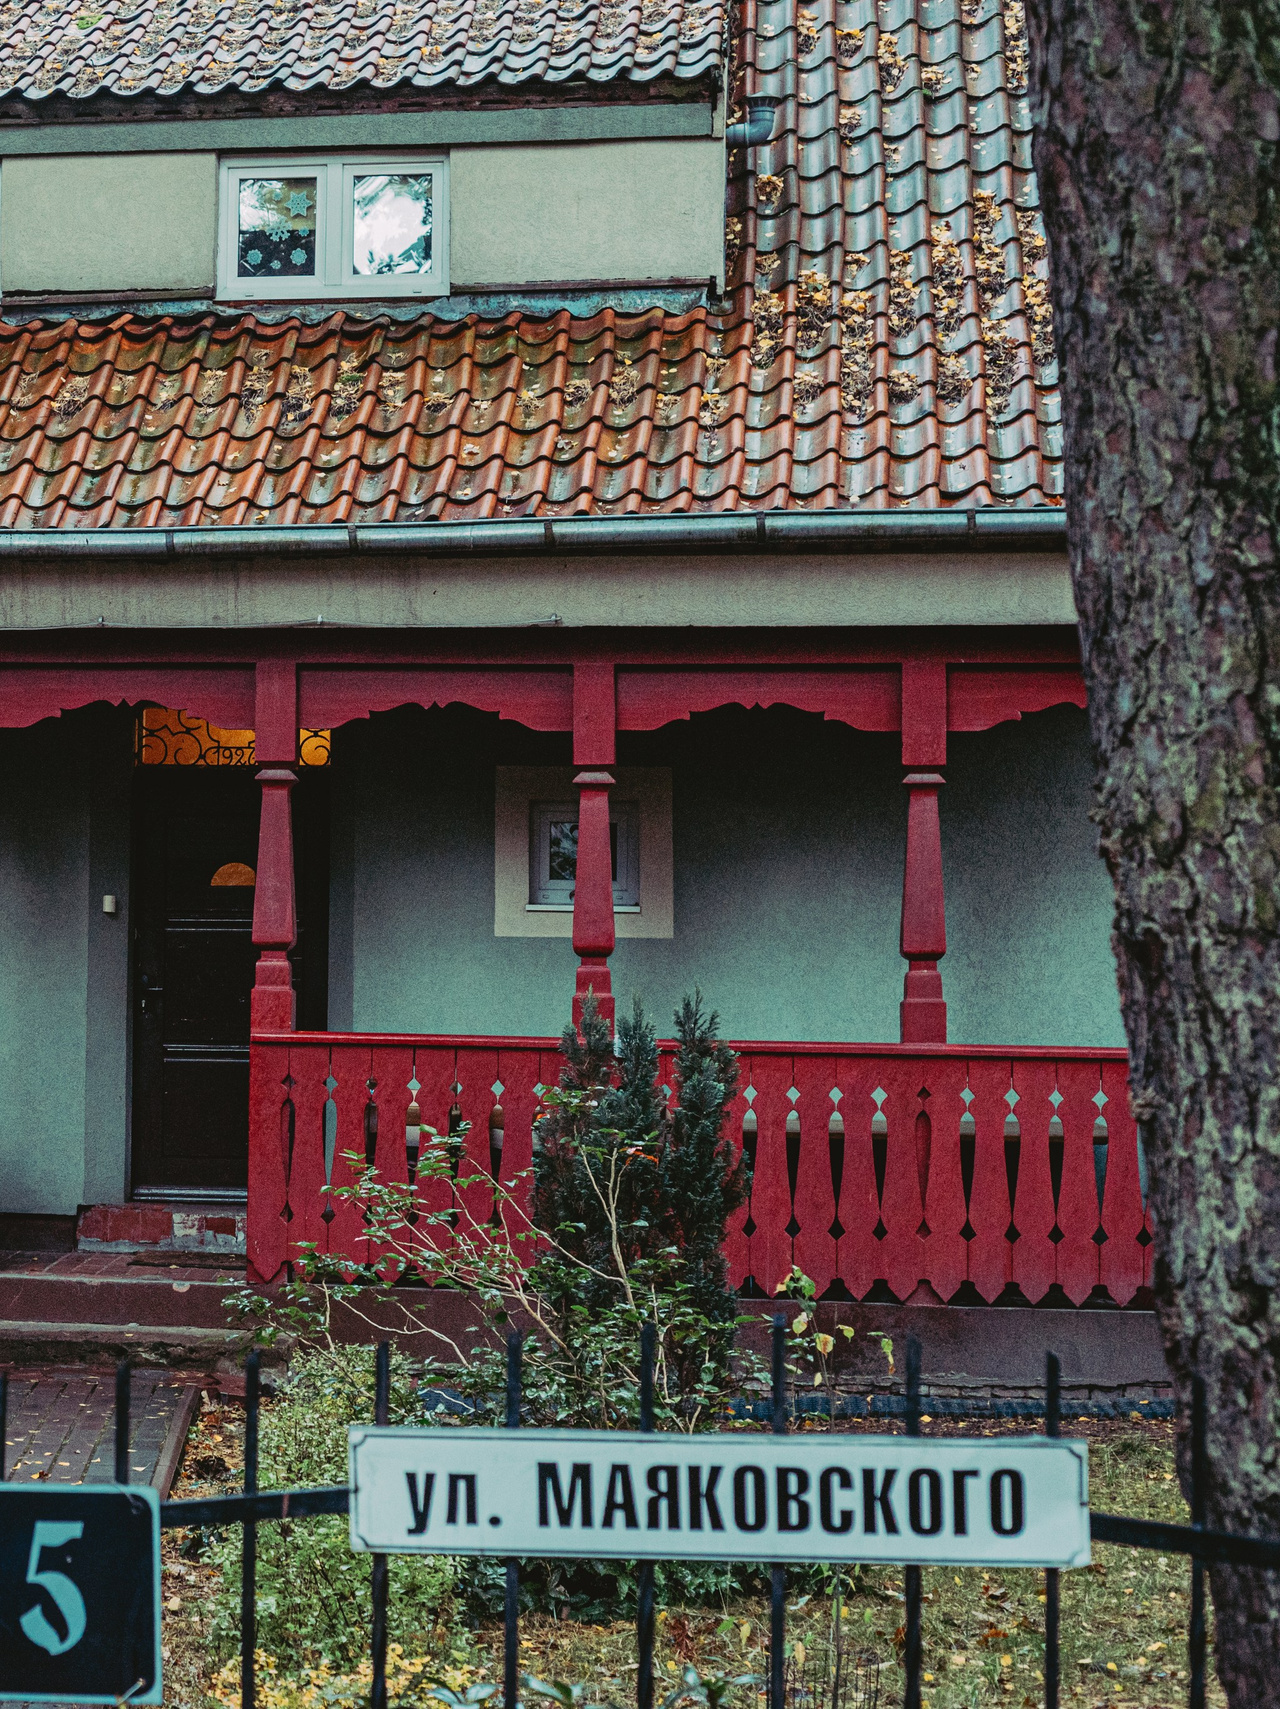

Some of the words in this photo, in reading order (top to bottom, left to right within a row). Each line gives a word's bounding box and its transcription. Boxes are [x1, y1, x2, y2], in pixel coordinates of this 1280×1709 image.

[405, 1472, 501, 1535] ул.
[537, 1461, 1026, 1538] МАЯКОВСКОГО
[19, 1520, 87, 1657] 5
